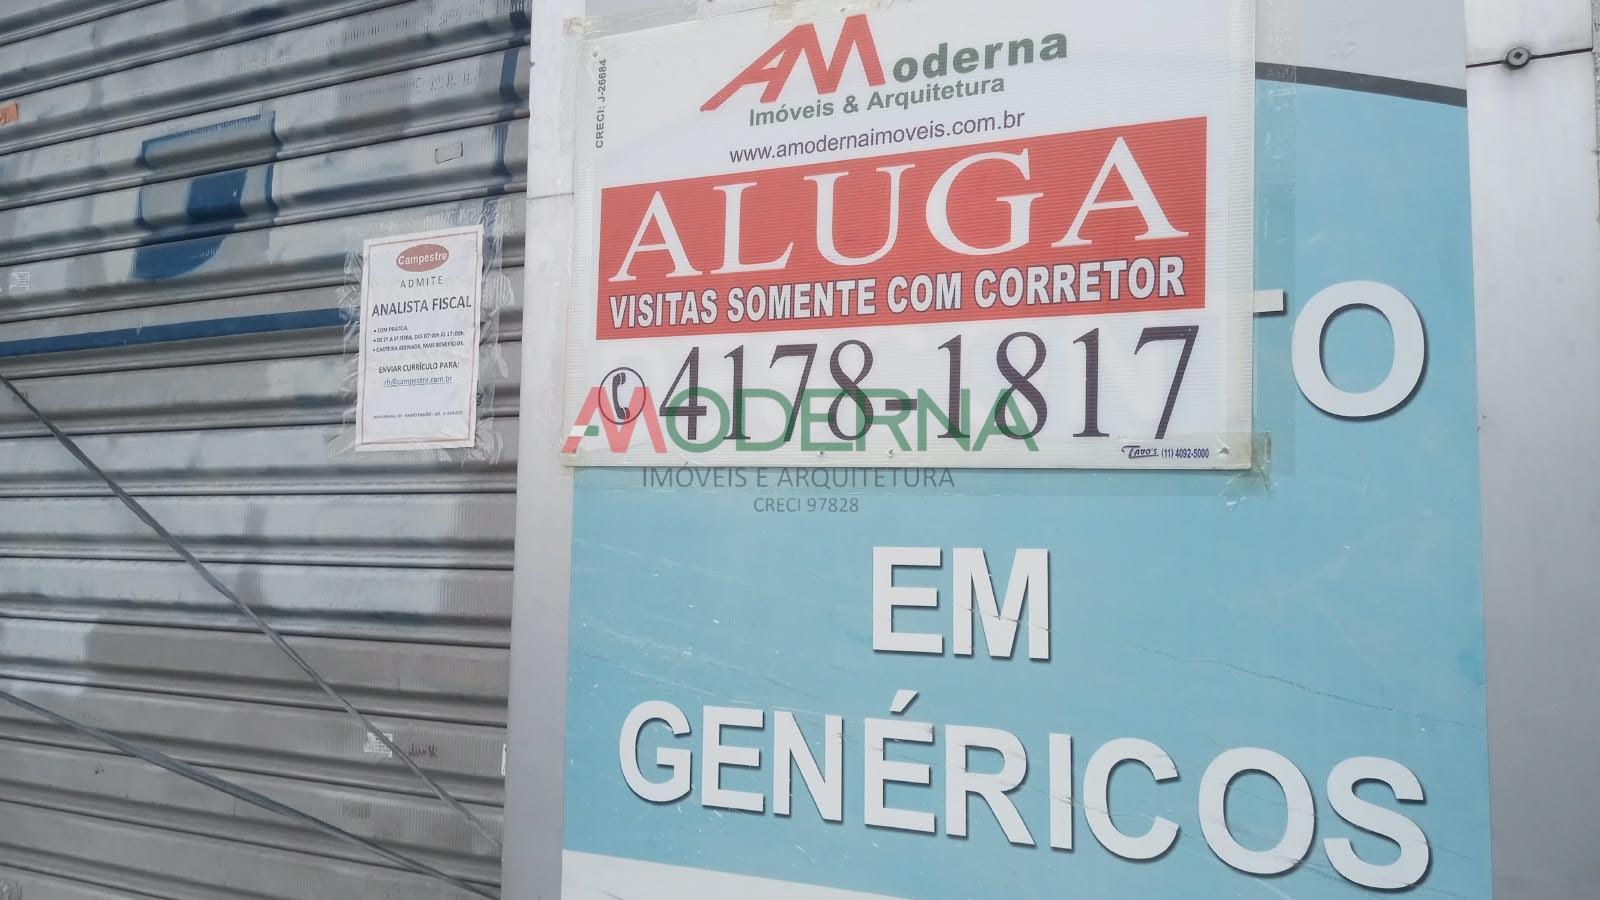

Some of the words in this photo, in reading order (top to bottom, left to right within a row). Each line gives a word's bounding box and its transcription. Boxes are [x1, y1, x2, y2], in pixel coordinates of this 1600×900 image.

[598, 58, 607, 103] J-26684
[749, 98, 834, 127] Imóveis
[842, 95, 859, 114] &
[867, 75, 1005, 112] Arquitetura
[595, 105, 605, 148] CRECI:
[729, 110, 1026, 164] www.amodernaimoveis.com.br
[608, 136, 1190, 283] ALUGA
[398, 252, 448, 266] Campestre
[400, 276, 443, 289] ADMITE
[608, 287, 718, 329] VISITAS
[726, 279, 877, 324] SOMENTE
[886, 270, 962, 314] COM
[973, 255, 1186, 307] CORRETOR
[372, 299, 429, 317] ANALISTA
[432, 295, 472, 311] FISCAL
[378, 365, 401, 374] ENVIAR
[402, 361, 438, 372] CURRÍCULO
[439, 361, 460, 369] PARA:
[384, 376, 453, 387] rh@campestre.com.br
[658, 325, 1200, 442] 4178-1817
[1161, 448, 1174, 459] (11)
[1175, 448, 1210, 459] 4092-5000
[872, 546, 1052, 662] EM
[618, 689, 1432, 890] GENÉRICOS
